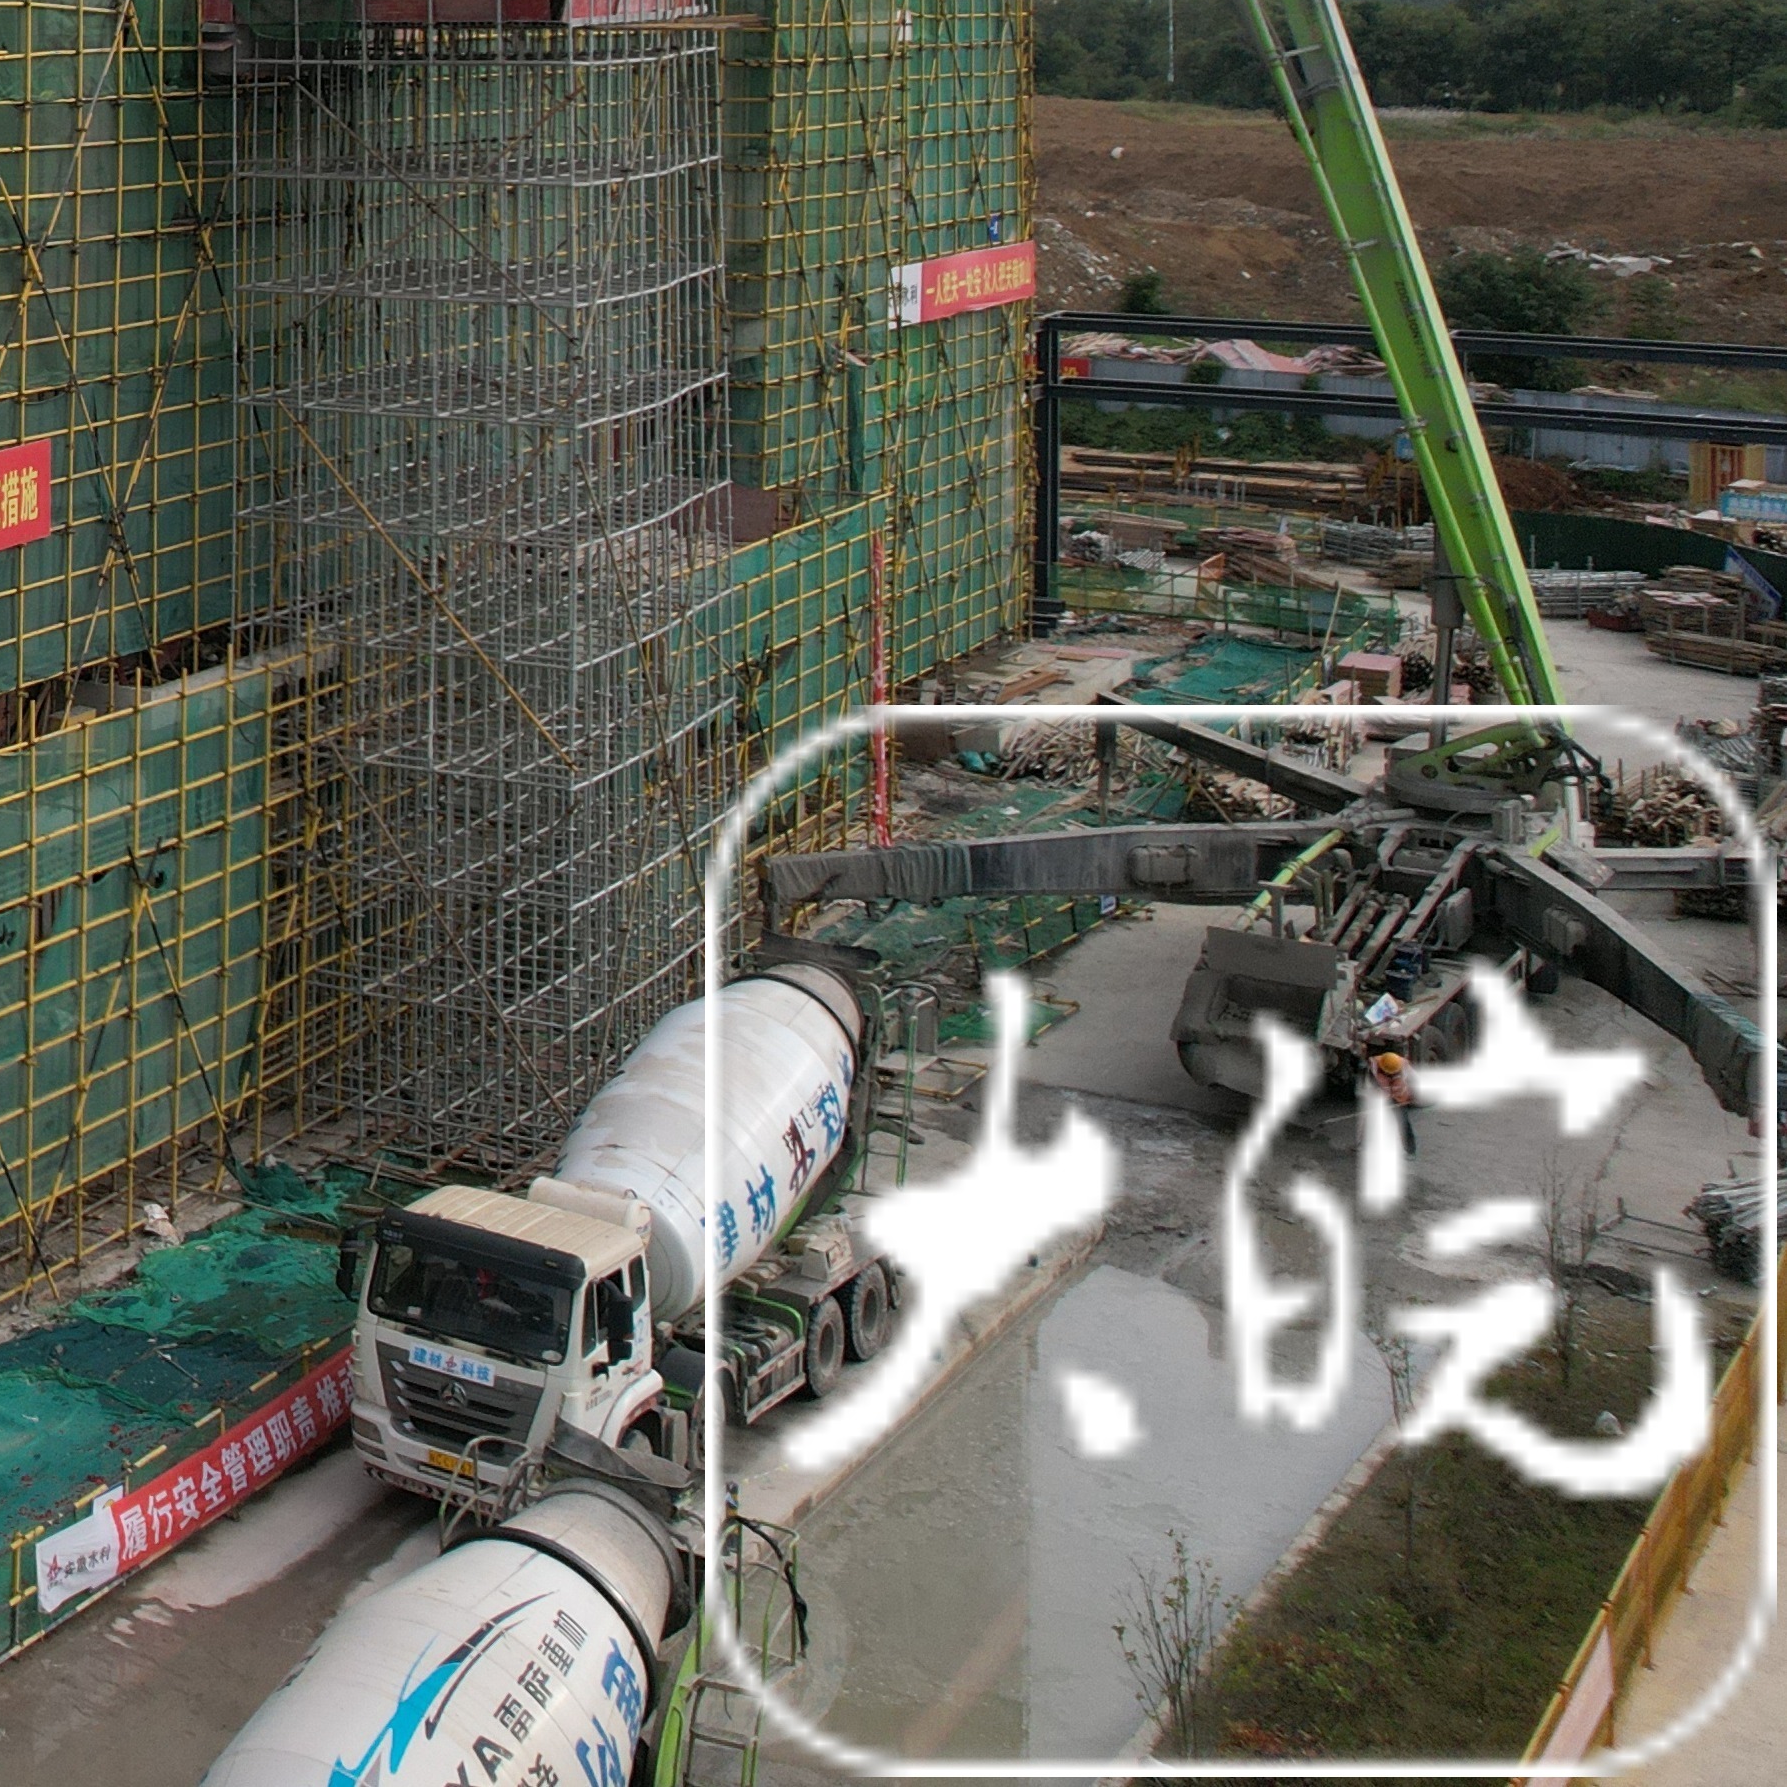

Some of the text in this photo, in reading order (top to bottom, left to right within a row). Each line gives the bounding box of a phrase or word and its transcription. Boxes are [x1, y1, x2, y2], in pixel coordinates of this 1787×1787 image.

[119, 1394, 318, 1560] 履行安全管理职责
